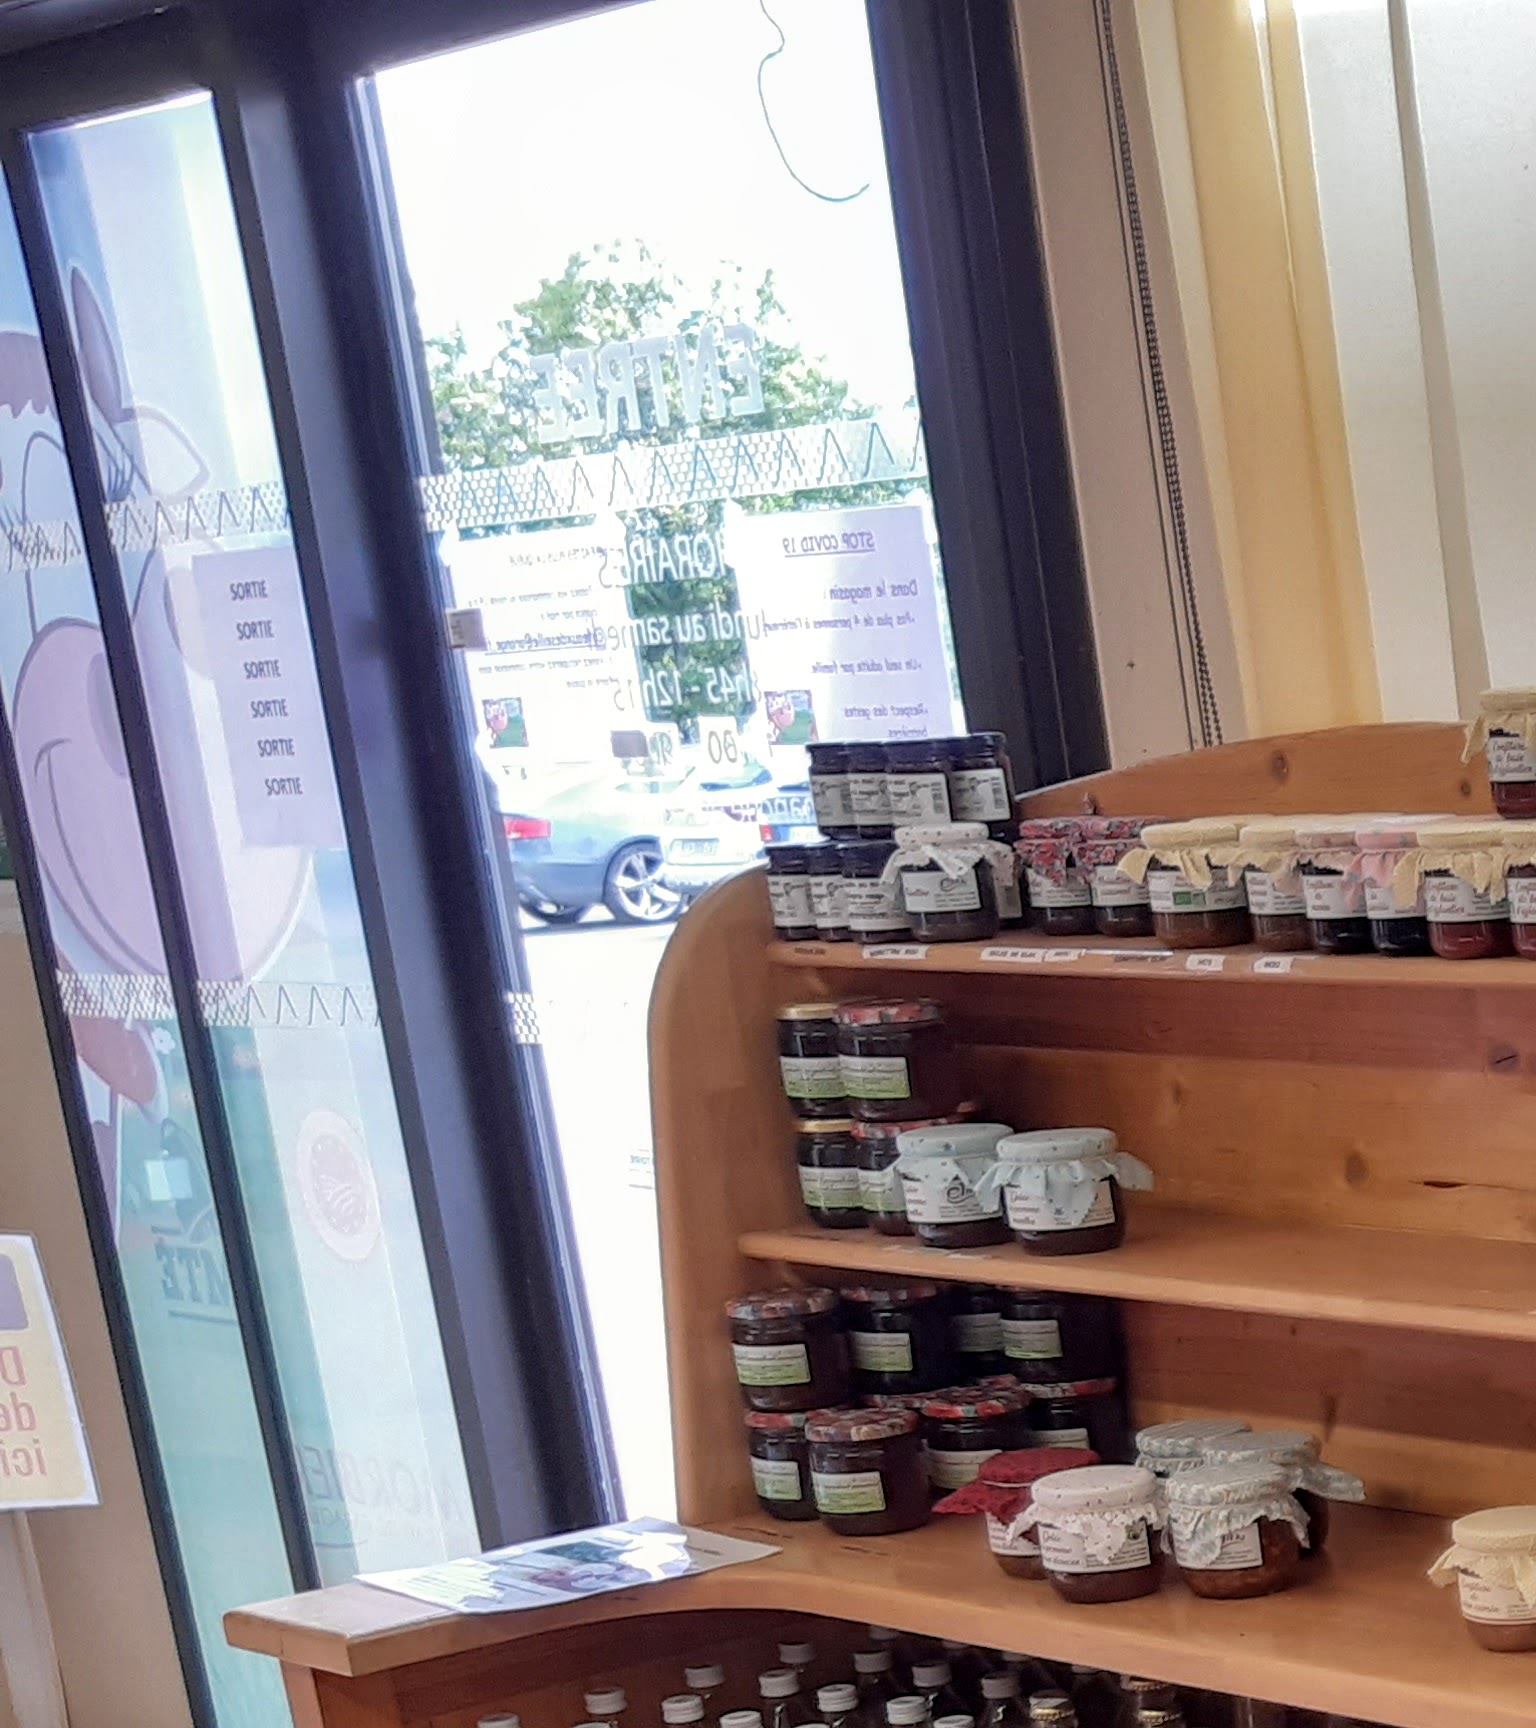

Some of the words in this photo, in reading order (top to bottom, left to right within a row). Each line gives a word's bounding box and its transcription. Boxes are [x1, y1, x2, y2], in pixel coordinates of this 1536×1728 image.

[230, 580, 268, 601] SORTIE
[237, 620, 274, 640] SORTIE
[244, 660, 281, 679] SORTIE
[251, 699, 288, 718] SORTIE
[258, 739, 295, 757] SORTIE
[265, 778, 302, 796] SORTIE
